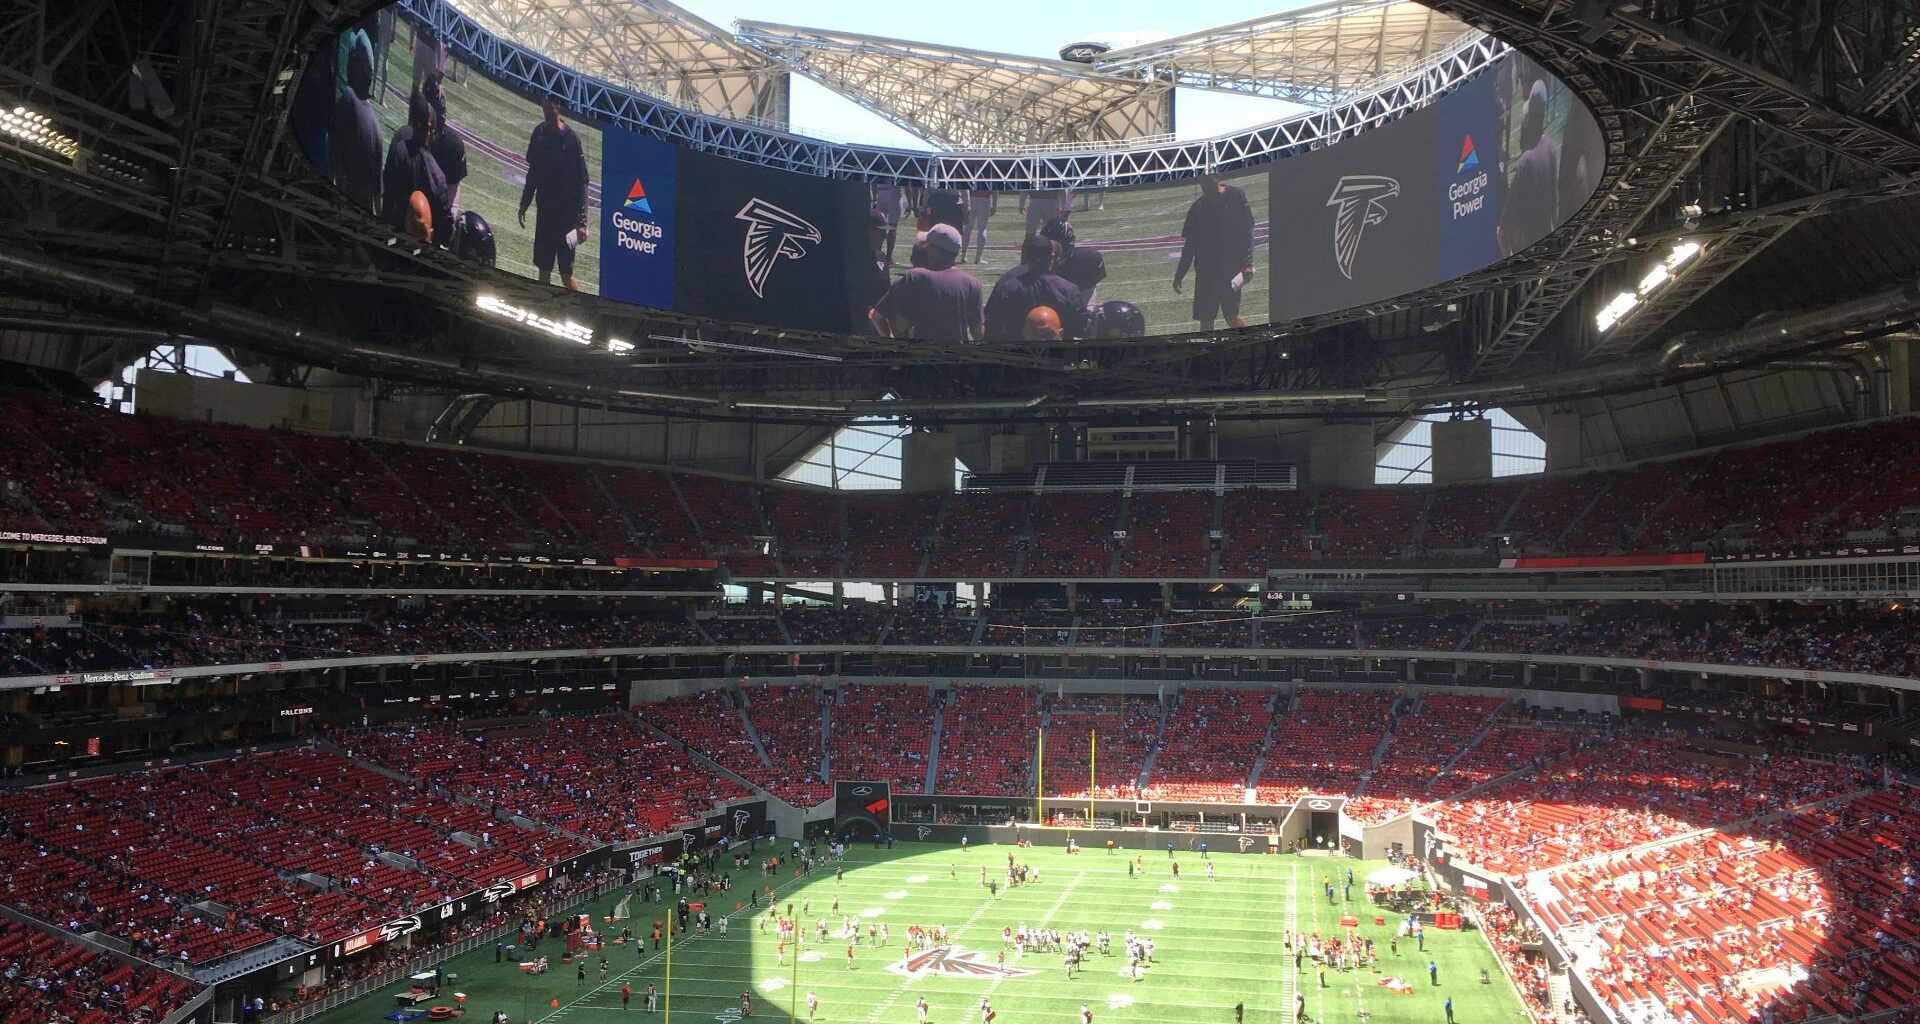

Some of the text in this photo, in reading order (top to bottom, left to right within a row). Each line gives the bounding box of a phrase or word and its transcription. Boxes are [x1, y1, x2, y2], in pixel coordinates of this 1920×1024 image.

[1448, 171, 1488, 201] Georgia
[1453, 194, 1484, 219] Power
[612, 211, 662, 238] Georgia
[617, 231, 657, 254] Power
[22, 533, 30, 541] TO
[31, 533, 81, 543] MERCEDES-BENZ
[83, 672, 129, 684] Mercedes-Benz
[129, 670, 154, 681] Stadium
[280, 707, 313, 716] FALCONS
[629, 846, 663, 863] TOGETHER
[344, 935, 368, 952] ATLANTA
